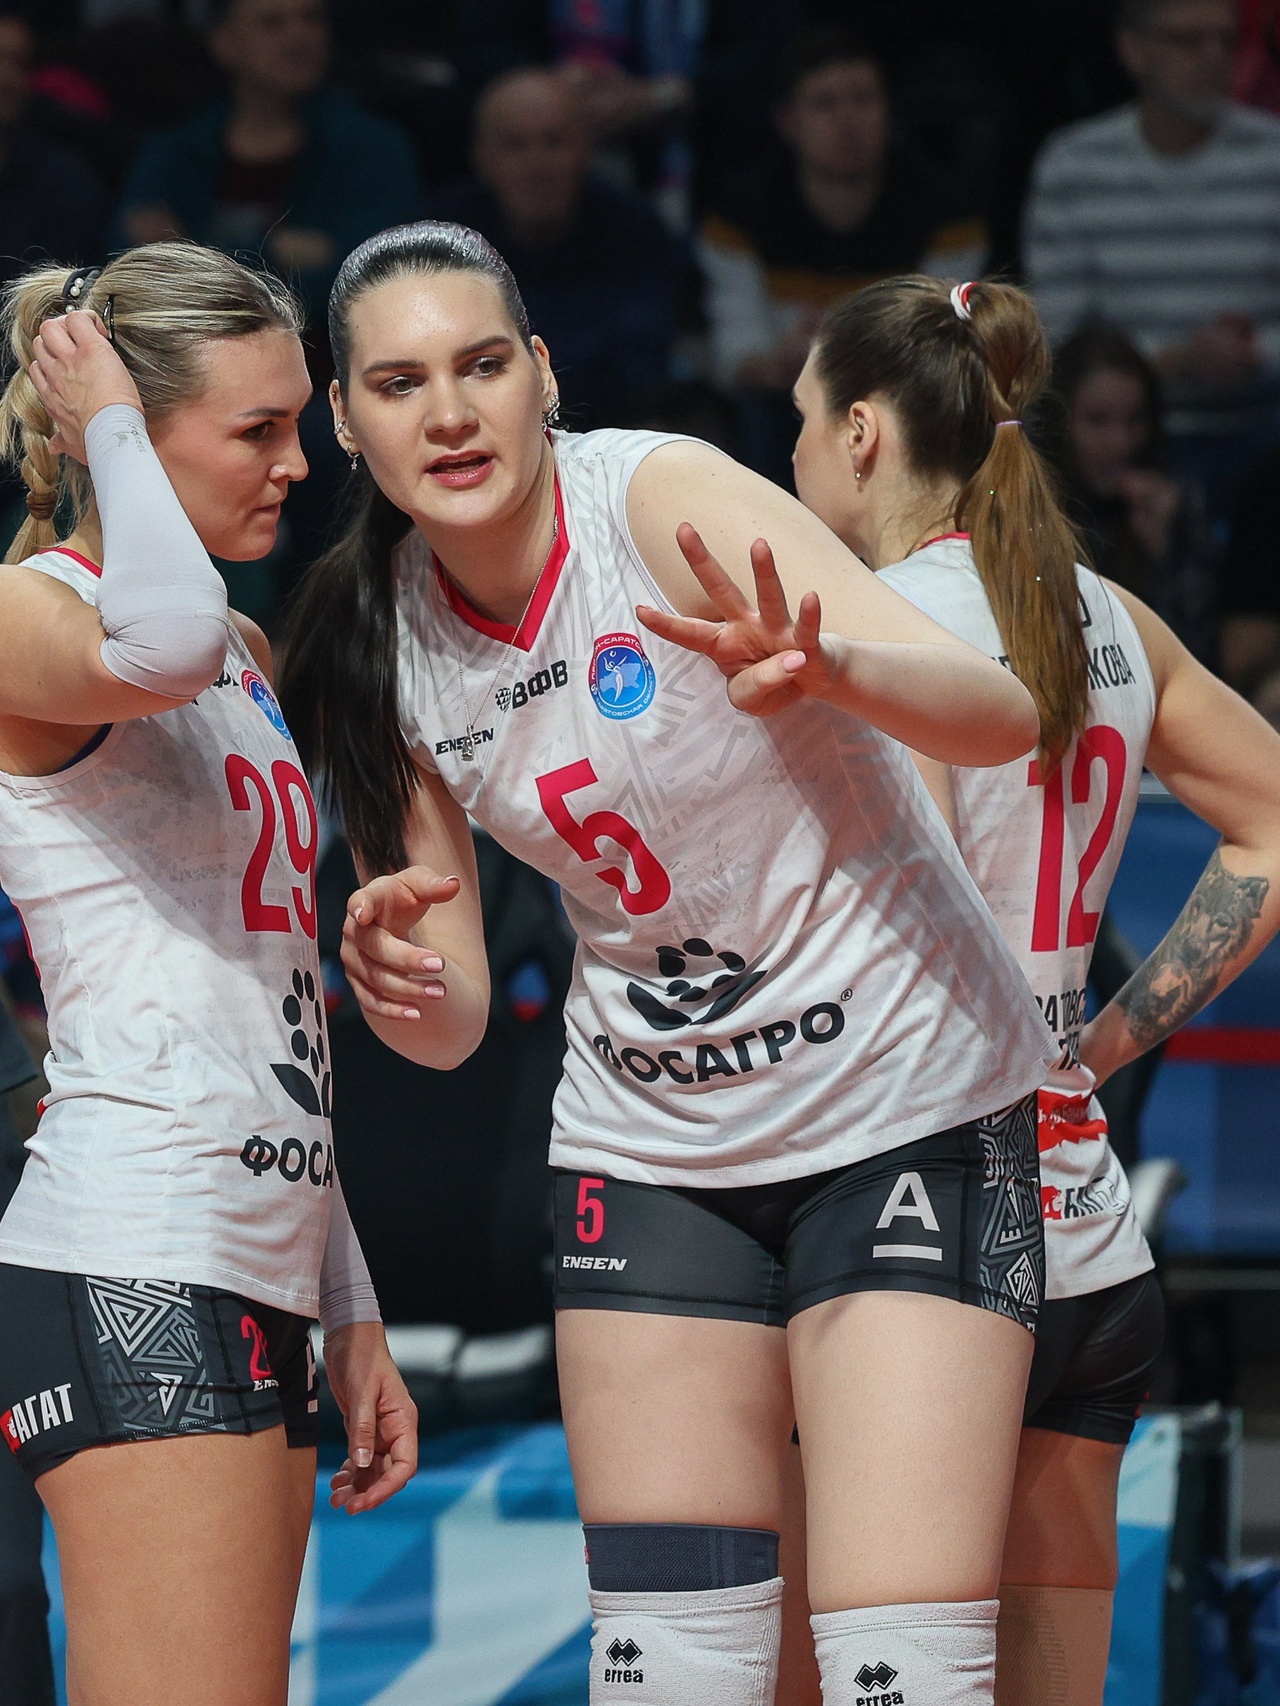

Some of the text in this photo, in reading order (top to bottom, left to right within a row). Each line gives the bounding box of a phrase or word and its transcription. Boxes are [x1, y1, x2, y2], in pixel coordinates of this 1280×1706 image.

[511, 659, 569, 710] ВФВ
[224, 752, 317, 940] 29
[534, 757, 671, 916] 5
[1026, 724, 1127, 953] 12
[592, 1001, 846, 1085] ФОСАГРО
[575, 1177, 606, 1244] 5
[562, 1255, 628, 1271] ENSEN
[11, 1382, 75, 1445] АГАТ
